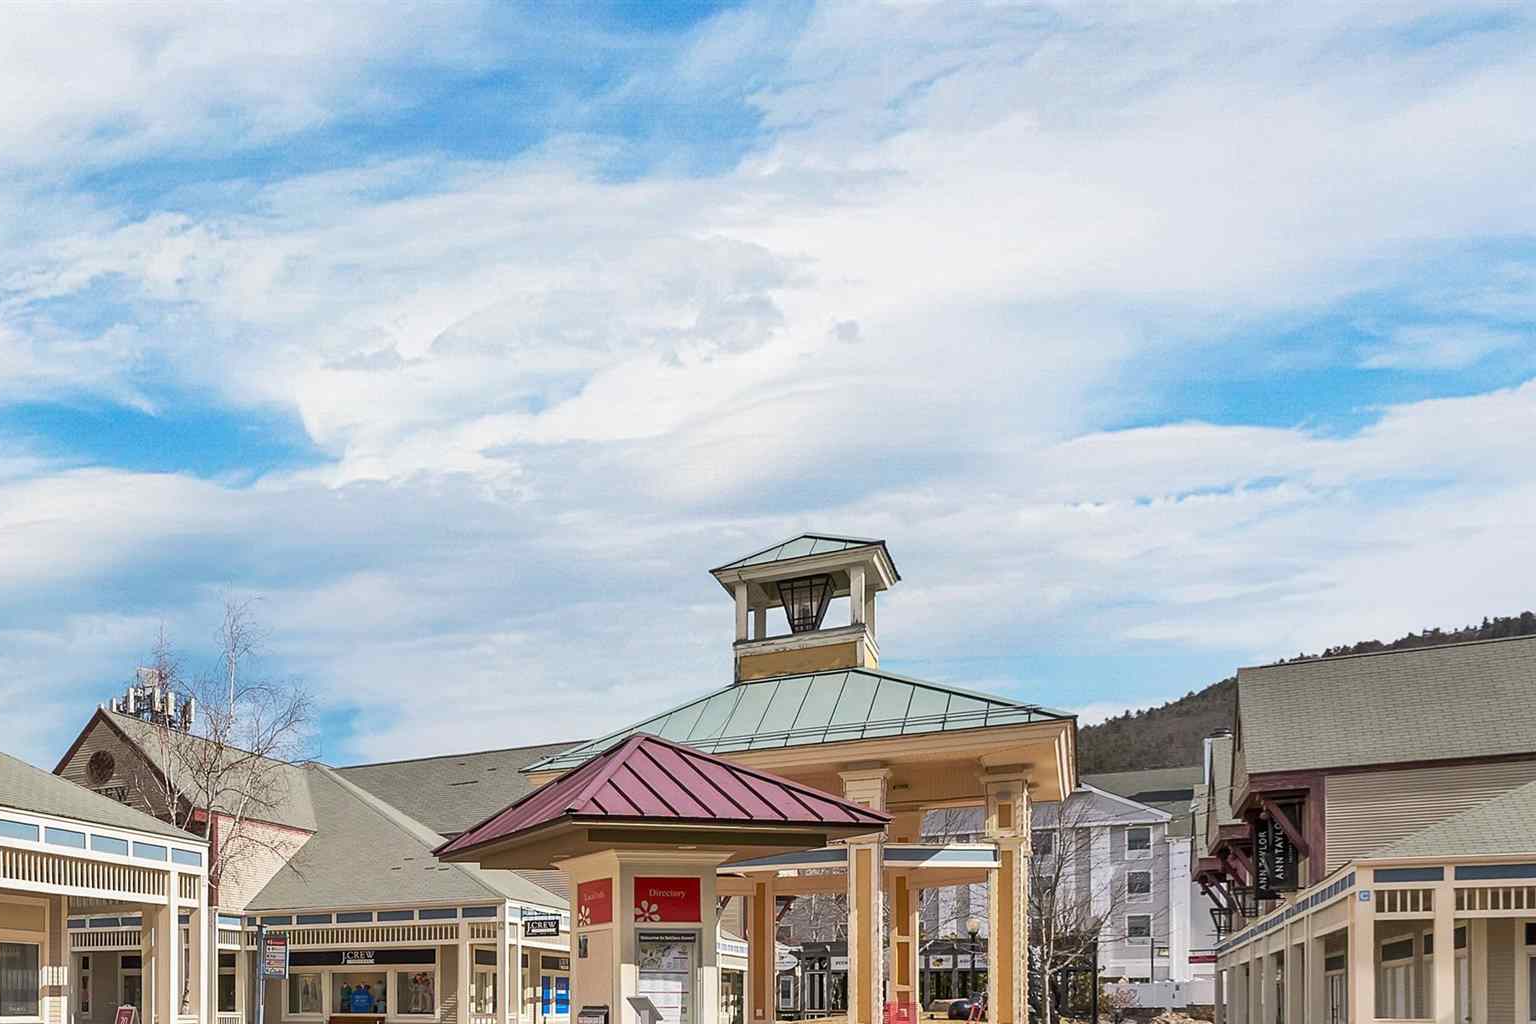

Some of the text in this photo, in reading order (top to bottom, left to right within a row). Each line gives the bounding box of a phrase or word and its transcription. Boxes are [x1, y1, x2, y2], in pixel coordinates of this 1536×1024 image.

[1274, 822, 1284, 880] ANN TAYLO
[649, 888, 686, 898] Directory
[341, 951, 376, 965] J.CREW
